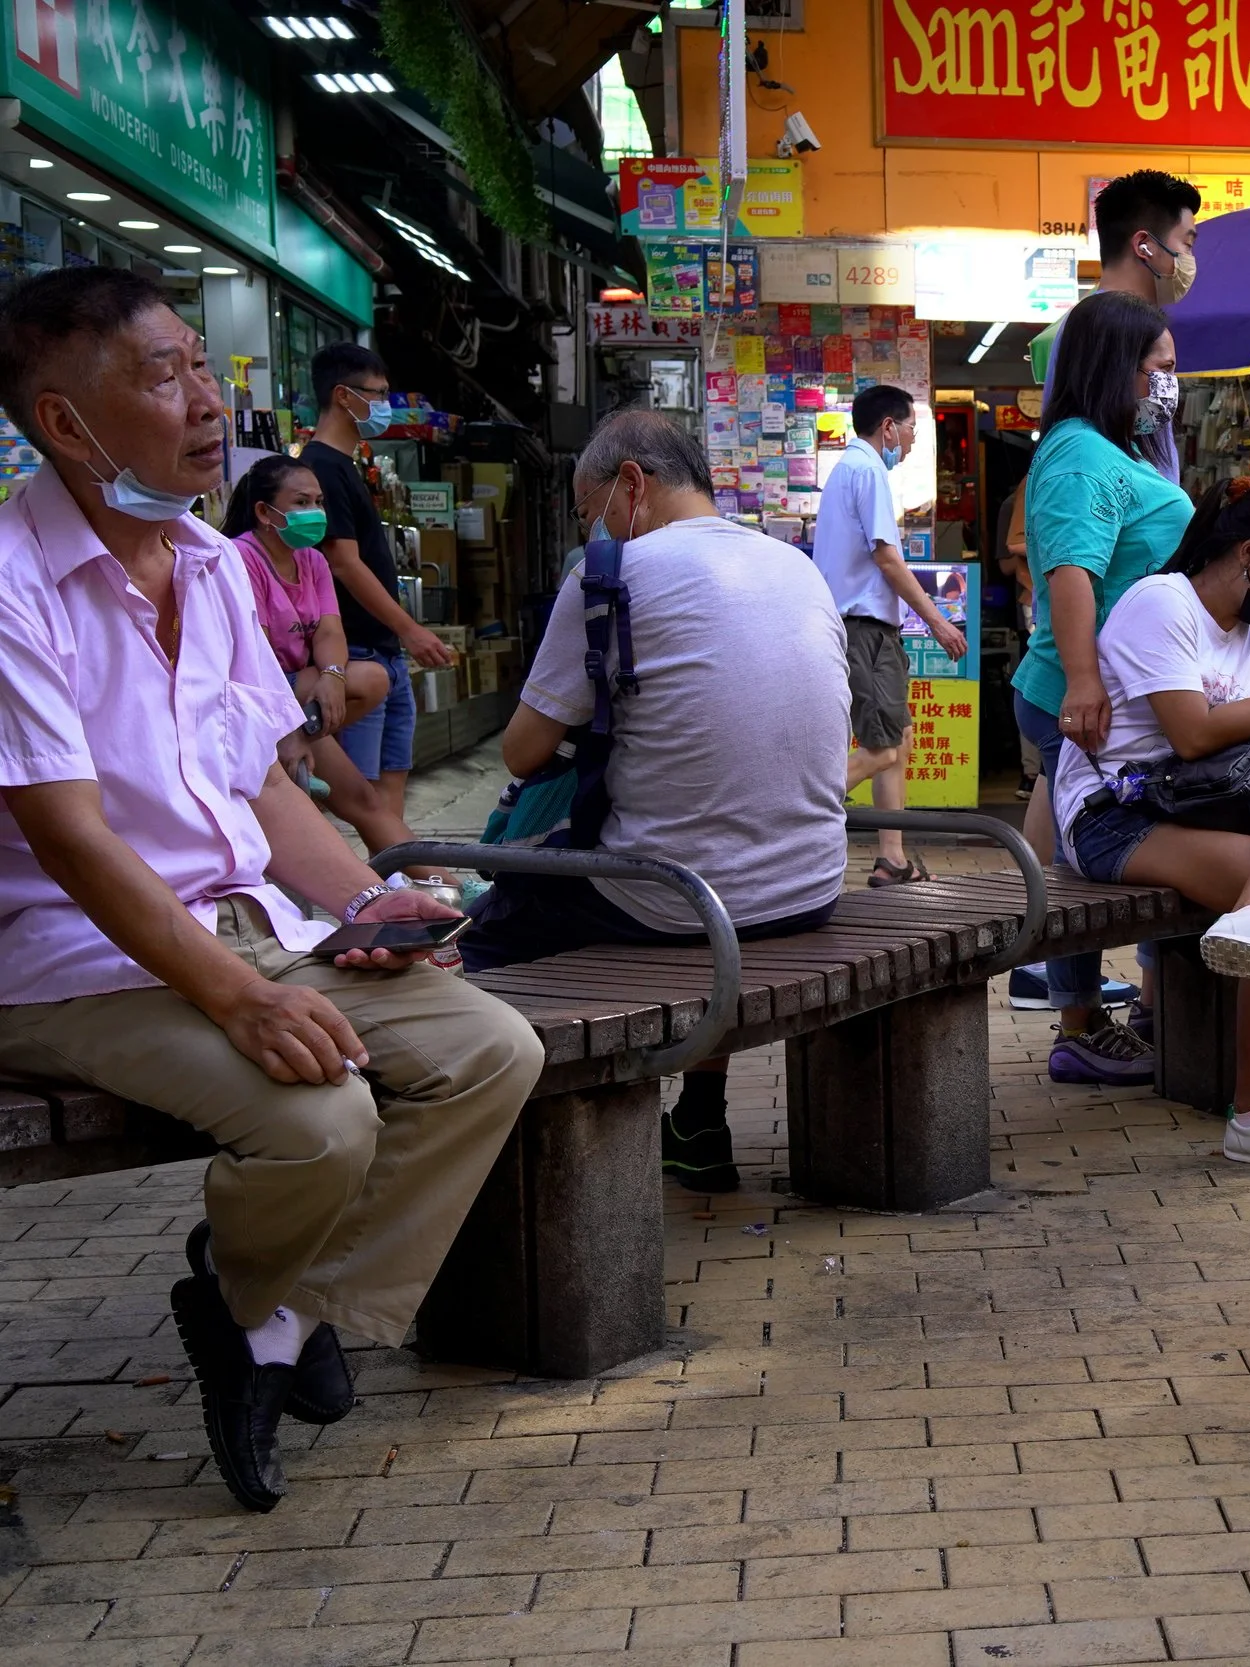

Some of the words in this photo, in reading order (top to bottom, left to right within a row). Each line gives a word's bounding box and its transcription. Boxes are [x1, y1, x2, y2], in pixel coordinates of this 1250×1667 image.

[89, 86, 163, 159] WONDERFUL
[170, 142, 229, 204] DISPENSARY
[235, 189, 267, 229] LIMITED
[845, 266, 899, 285] 4289
[911, 680, 934, 700] 訊
[912, 737, 951, 749] 觸屏
[924, 752, 970, 765] 充值卡
